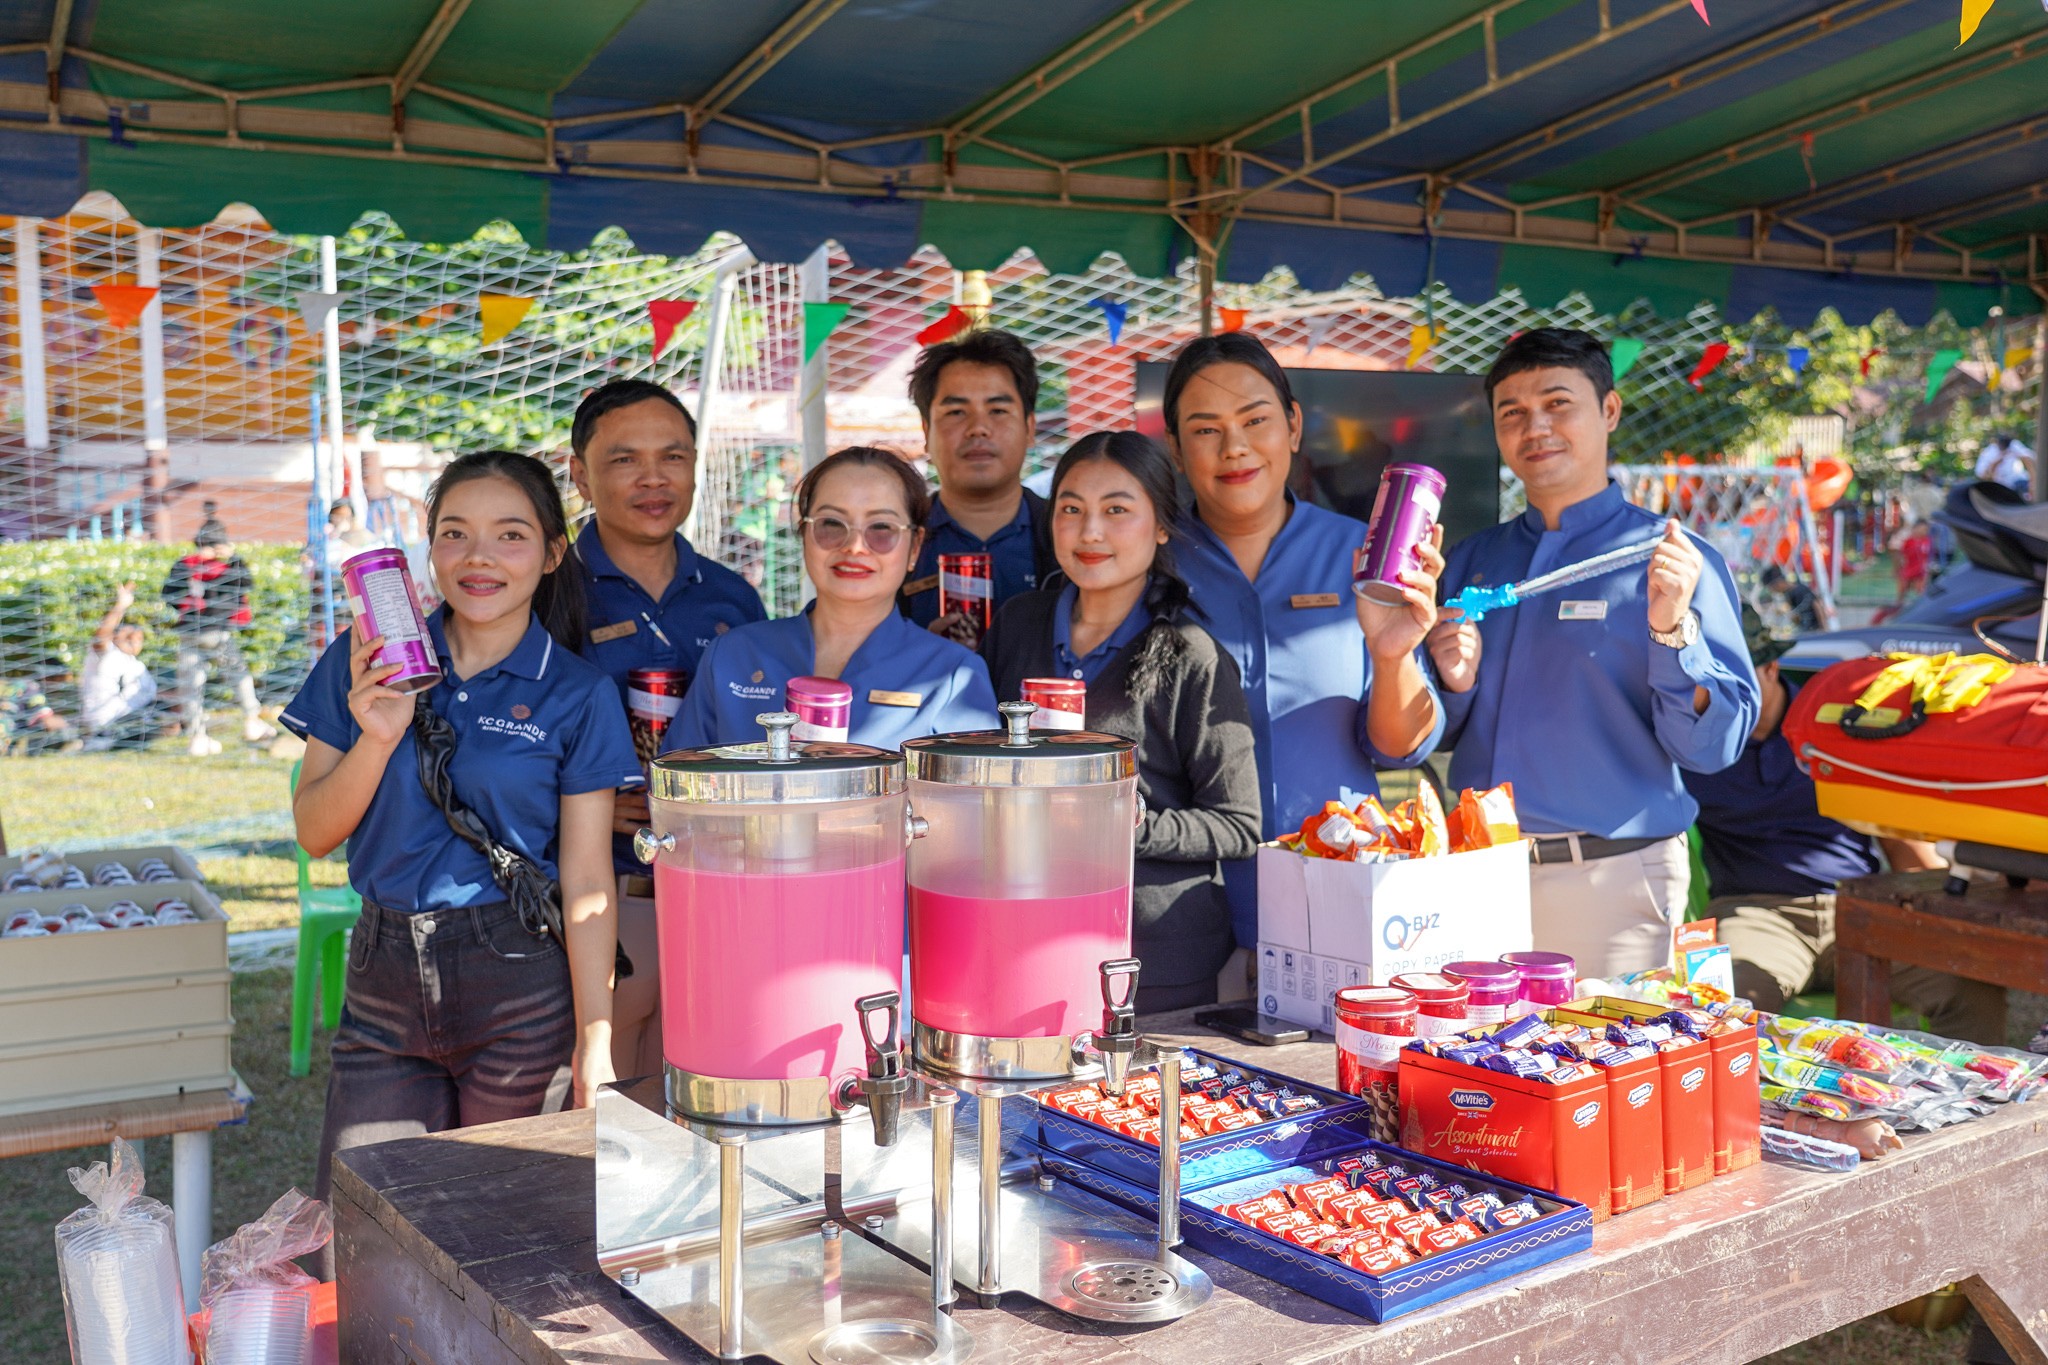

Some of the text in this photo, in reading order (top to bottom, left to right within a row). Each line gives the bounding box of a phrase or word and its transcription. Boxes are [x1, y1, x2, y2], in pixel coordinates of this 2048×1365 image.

[742, 686, 777, 696] GRANDE
[478, 716, 547, 741] KC GRANDE
[1382, 950, 1464, 976] COPY PAPER
[1454, 1094, 1489, 1106] McVitie's
[1428, 1117, 1532, 1149] Assortment
[1453, 1144, 1517, 1157] Biscuit Selection
